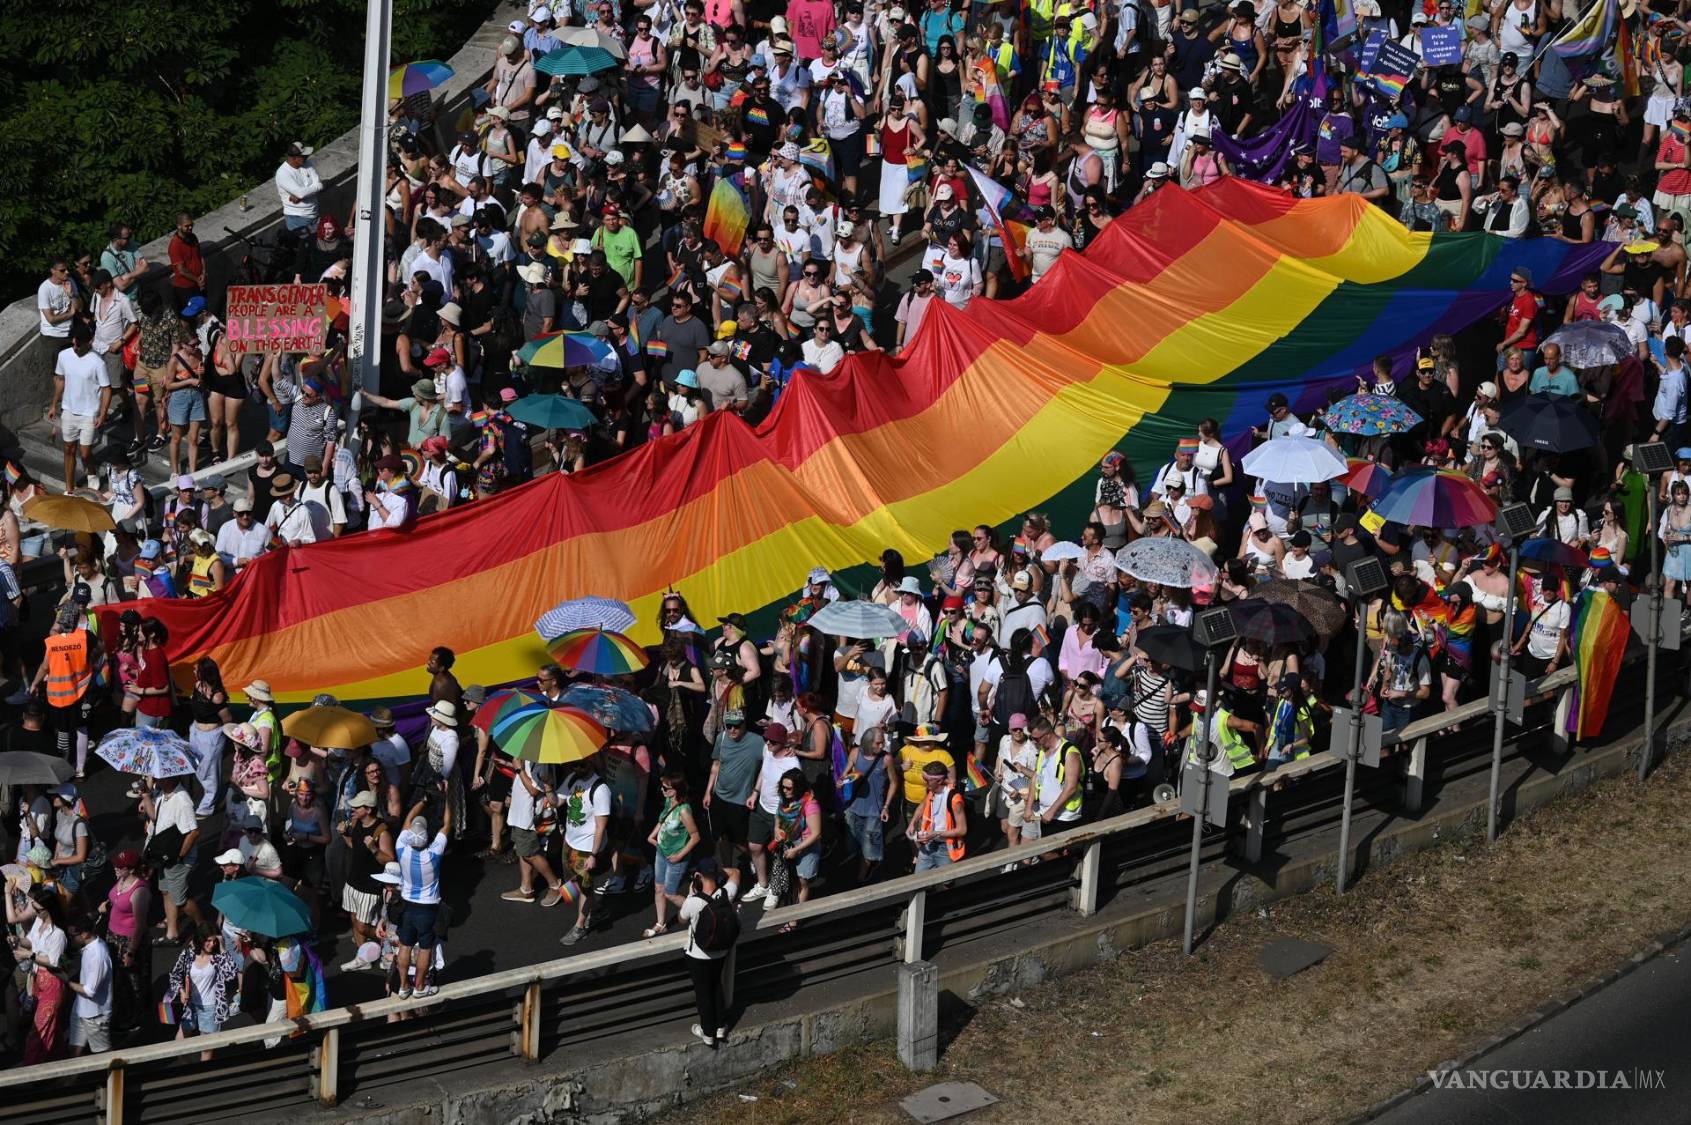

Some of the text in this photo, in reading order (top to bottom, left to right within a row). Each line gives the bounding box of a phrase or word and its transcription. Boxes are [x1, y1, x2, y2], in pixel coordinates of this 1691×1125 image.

[228, 285, 325, 306] TRANSGENDER
[228, 304, 314, 317] PEOPLE ARE A
[227, 317, 322, 341] BLESSING
[229, 335, 323, 353] ON THIS EARTH
